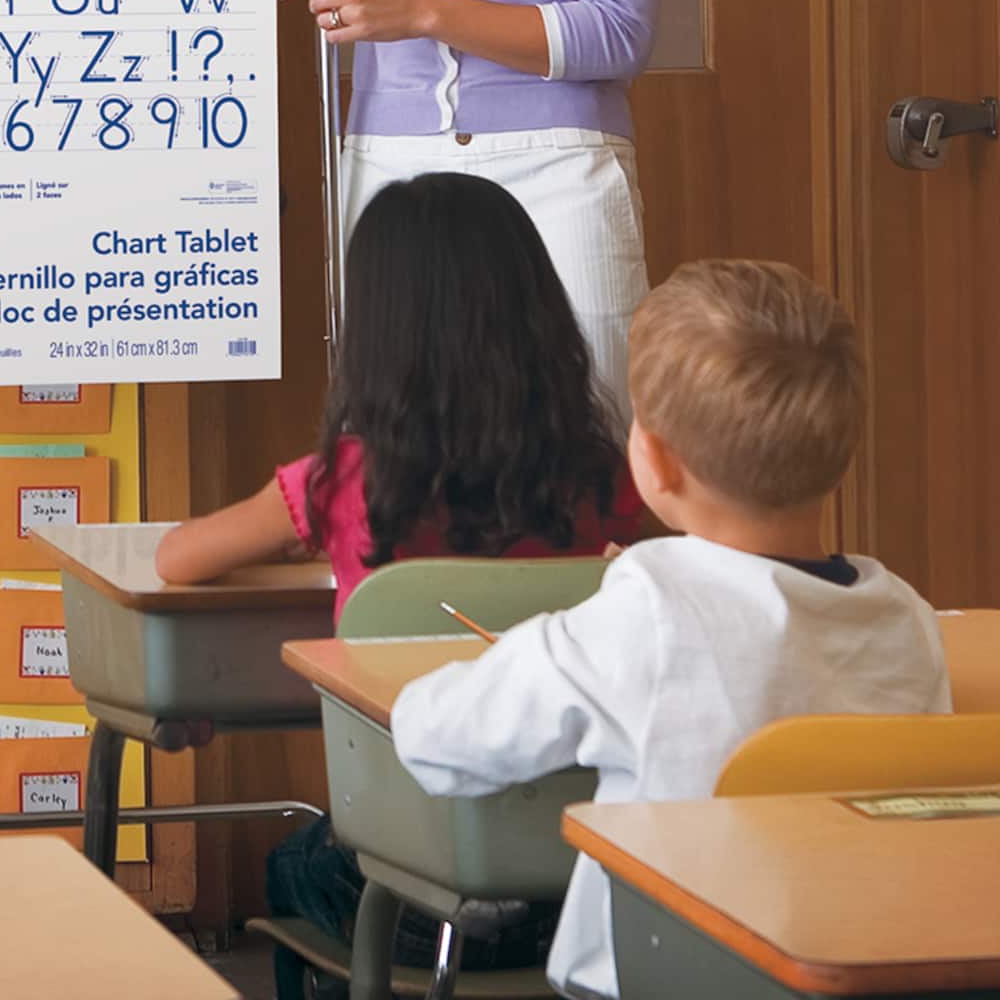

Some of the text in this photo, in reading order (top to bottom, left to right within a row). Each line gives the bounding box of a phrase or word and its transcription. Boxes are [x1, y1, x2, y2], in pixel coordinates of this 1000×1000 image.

[80, 31, 144, 82] Zz
[6, 100, 34, 152] 6
[52, 100, 83, 151] 7
[98, 100, 133, 150] 8
[151, 99, 180, 149] 9
[202, 97, 248, 149] 10
[92, 229, 259, 255] Chart Tablet
[85, 270, 145, 295] para
[154, 262, 259, 294] gráficas
[43, 298, 78, 323] de
[88, 296, 258, 328] présentation
